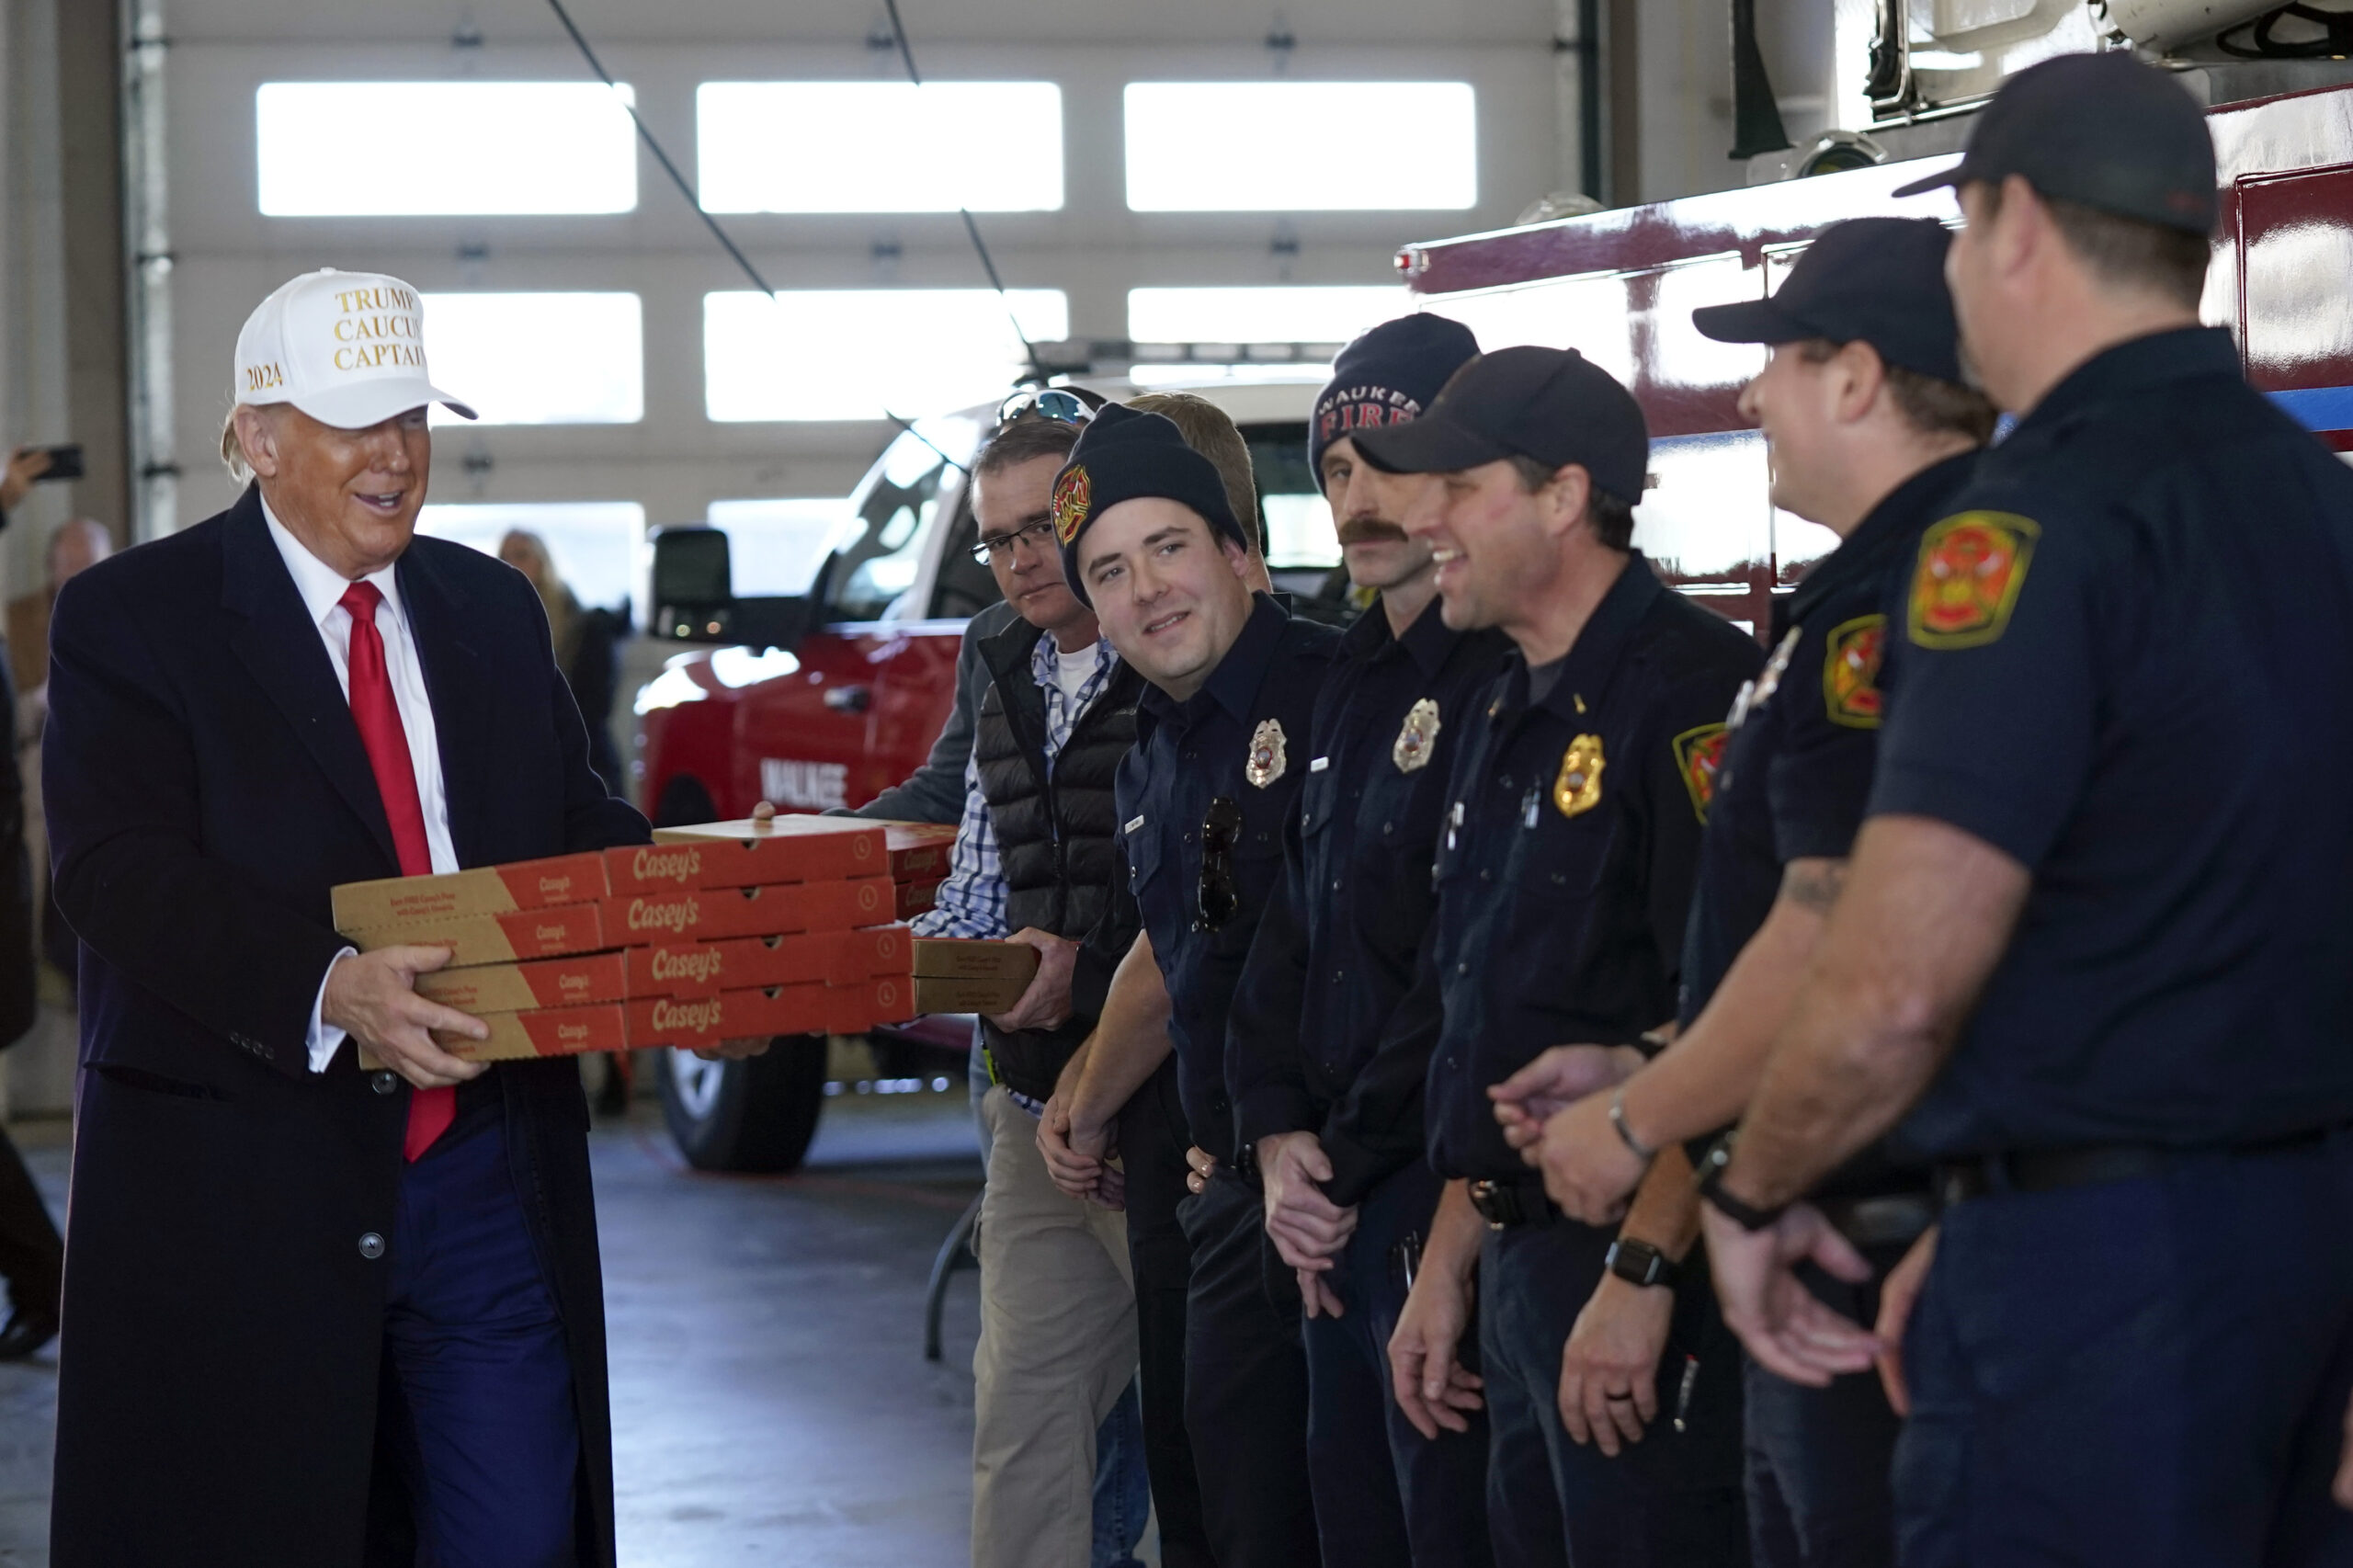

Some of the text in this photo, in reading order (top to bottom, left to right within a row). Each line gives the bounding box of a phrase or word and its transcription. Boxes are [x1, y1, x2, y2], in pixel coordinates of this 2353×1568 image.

[335, 287, 414, 313] TRUMP
[246, 361, 283, 392] 2024
[1318, 385, 1421, 415] WAUKEE
[632, 846, 701, 883] Casey's
[627, 896, 699, 933] Casey's
[652, 946, 722, 982] Casey's
[652, 998, 722, 1033] Casey's
